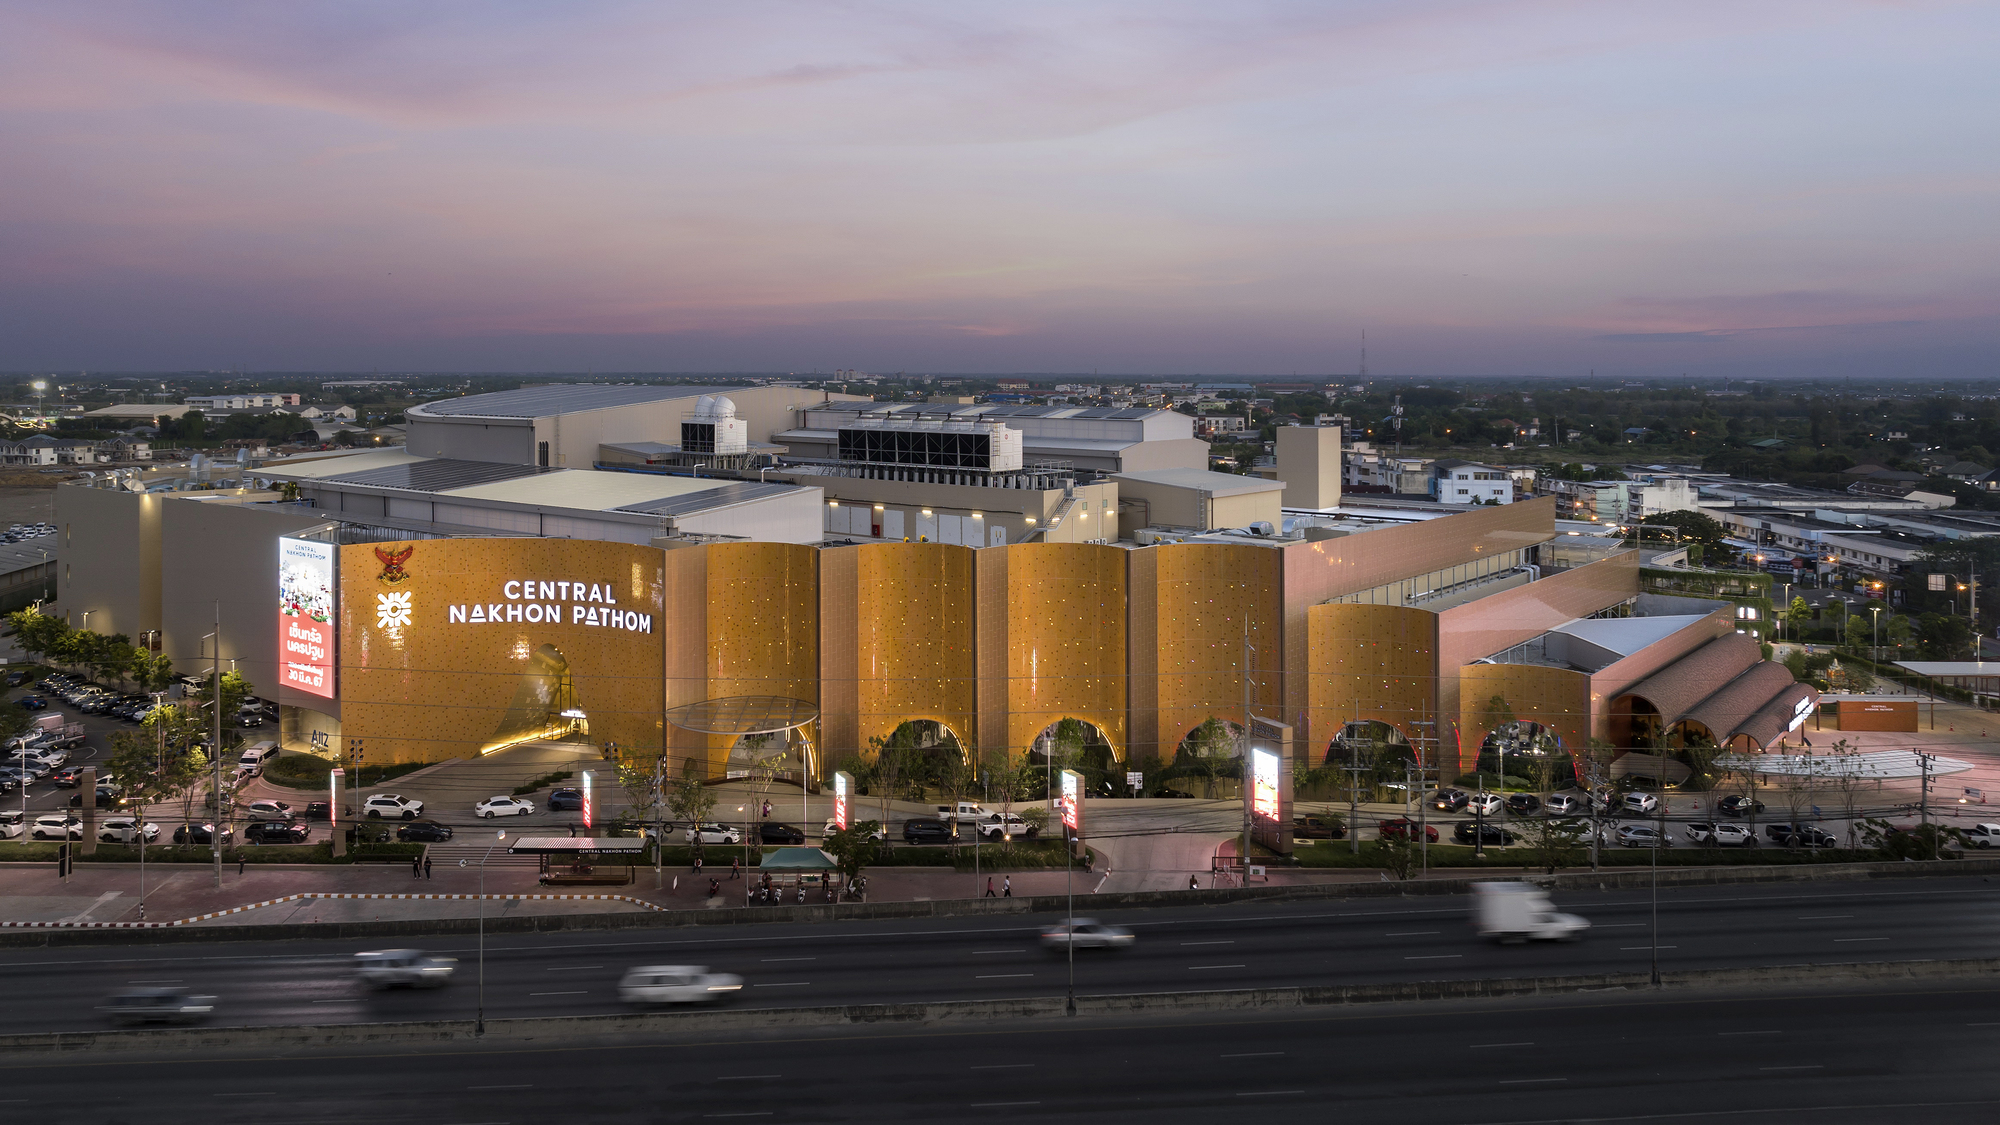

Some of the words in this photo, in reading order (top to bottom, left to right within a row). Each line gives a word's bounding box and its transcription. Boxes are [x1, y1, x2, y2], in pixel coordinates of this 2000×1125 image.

[294, 544, 317, 553] CENTRAL
[504, 580, 617, 605] CENTRAL
[449, 603, 562, 624] NAKHON
[573, 605, 653, 634] PATHOM
[289, 621, 322, 644] เซ็นทรัล
[287, 639, 324, 661] นครปฐม
[288, 669, 298, 681] 30
[298, 671, 313, 685] มี.ค.
[313, 675, 323, 687] 67
